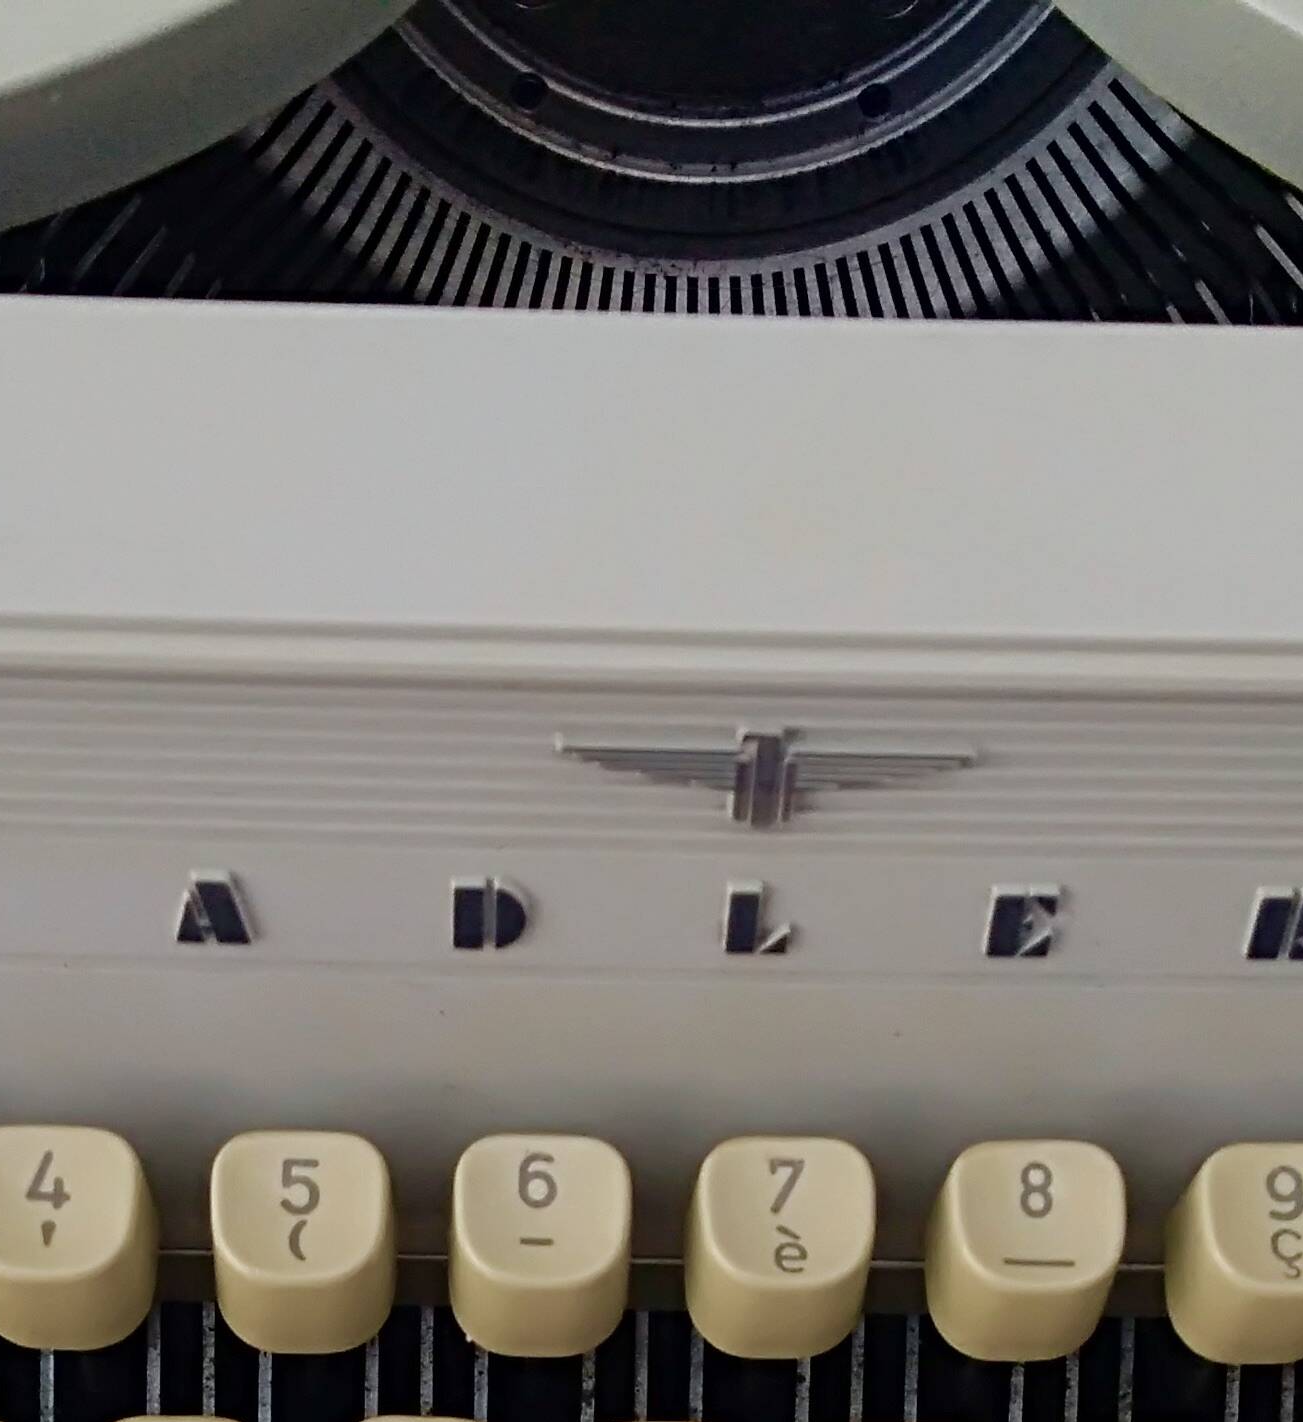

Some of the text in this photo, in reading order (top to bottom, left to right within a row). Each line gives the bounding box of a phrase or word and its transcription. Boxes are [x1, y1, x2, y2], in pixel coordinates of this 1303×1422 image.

[25, 1149, 71, 1211] 4
[279, 1158, 321, 1217] 5
[517, 1151, 558, 1210] 6
[768, 1157, 806, 1215] 7
[1019, 1161, 1054, 1219] 8
[287, 1218, 310, 1263] (
[773, 1224, 808, 1274] è
